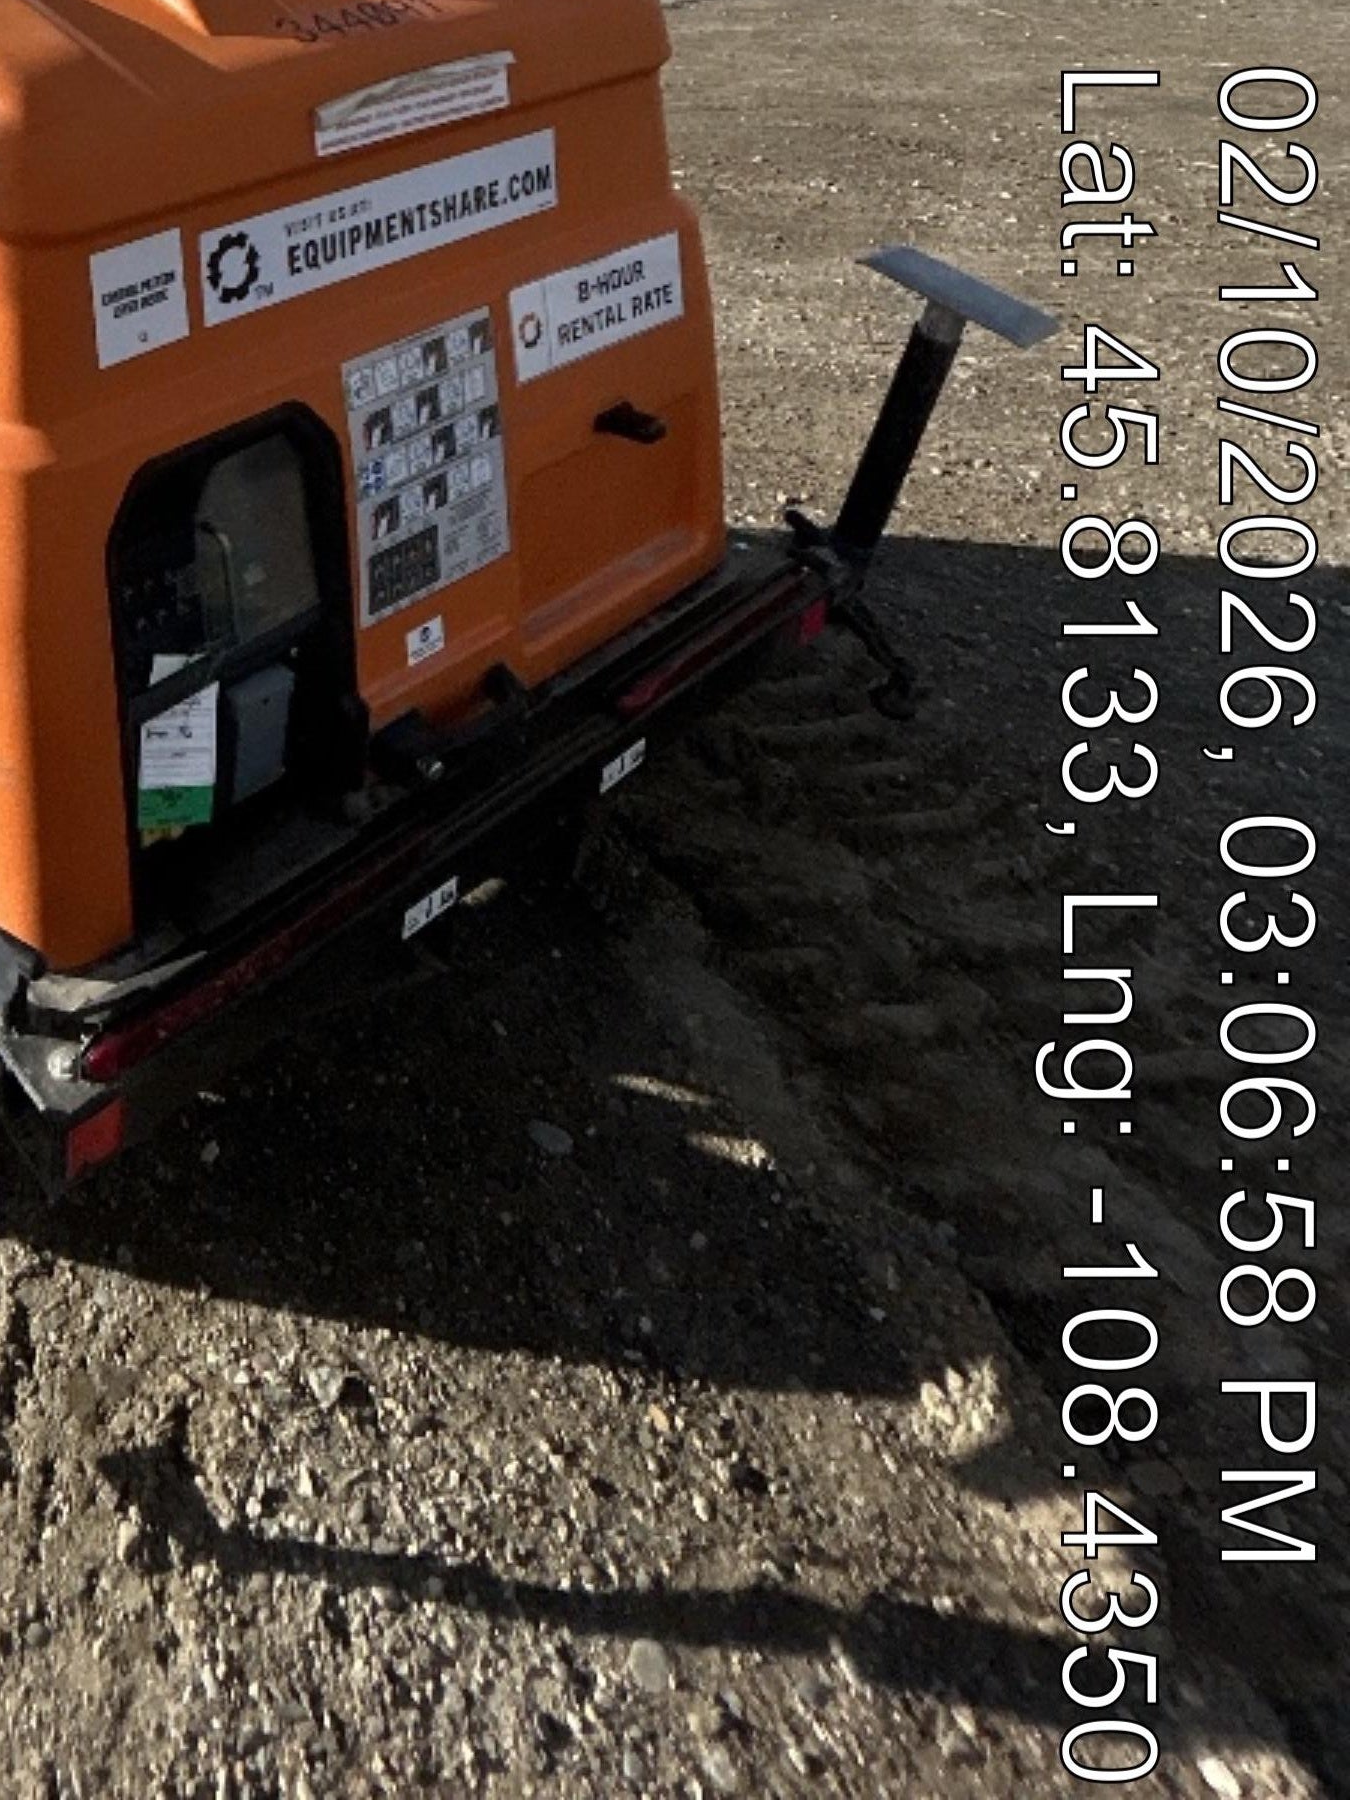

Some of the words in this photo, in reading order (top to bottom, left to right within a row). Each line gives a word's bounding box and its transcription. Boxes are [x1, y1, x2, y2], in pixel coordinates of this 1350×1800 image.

[287, 163, 552, 277] EQUIPMENTSHARE.COM
[577, 259, 646, 304] 8-HOUR
[557, 303, 628, 347] RENTAL
[631, 283, 673, 318] RATE
